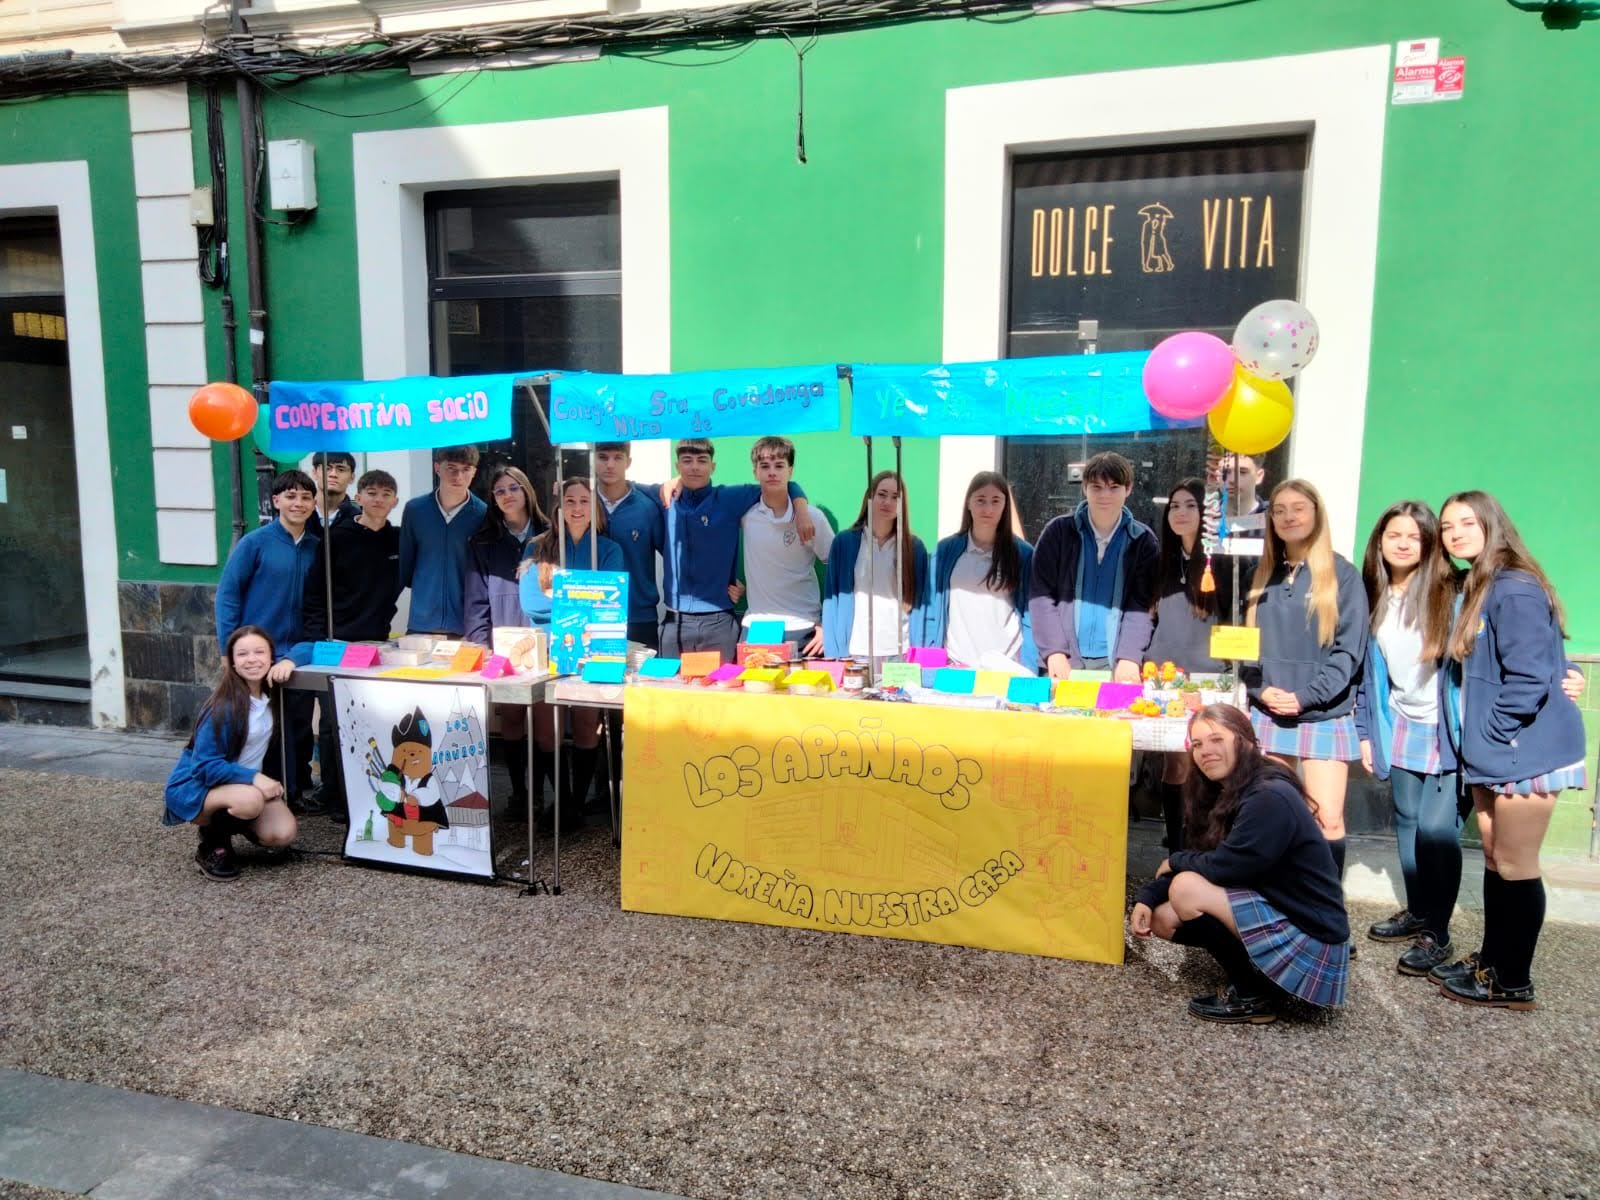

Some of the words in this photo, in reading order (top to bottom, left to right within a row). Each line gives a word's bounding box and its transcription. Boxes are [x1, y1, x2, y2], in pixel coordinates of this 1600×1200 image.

[1031, 204, 1115, 277] DOLCE
[1203, 195, 1274, 270] VITA
[712, 381, 825, 411] Covadonga
[874, 388, 906, 419] Ye
[690, 413, 713, 433] de
[445, 717, 469, 733] LOS
[683, 745, 763, 808] LOS
[771, 716, 983, 811] APAÑAOS
[823, 886, 959, 928] NUESTRA
[958, 850, 1025, 907] CASA
